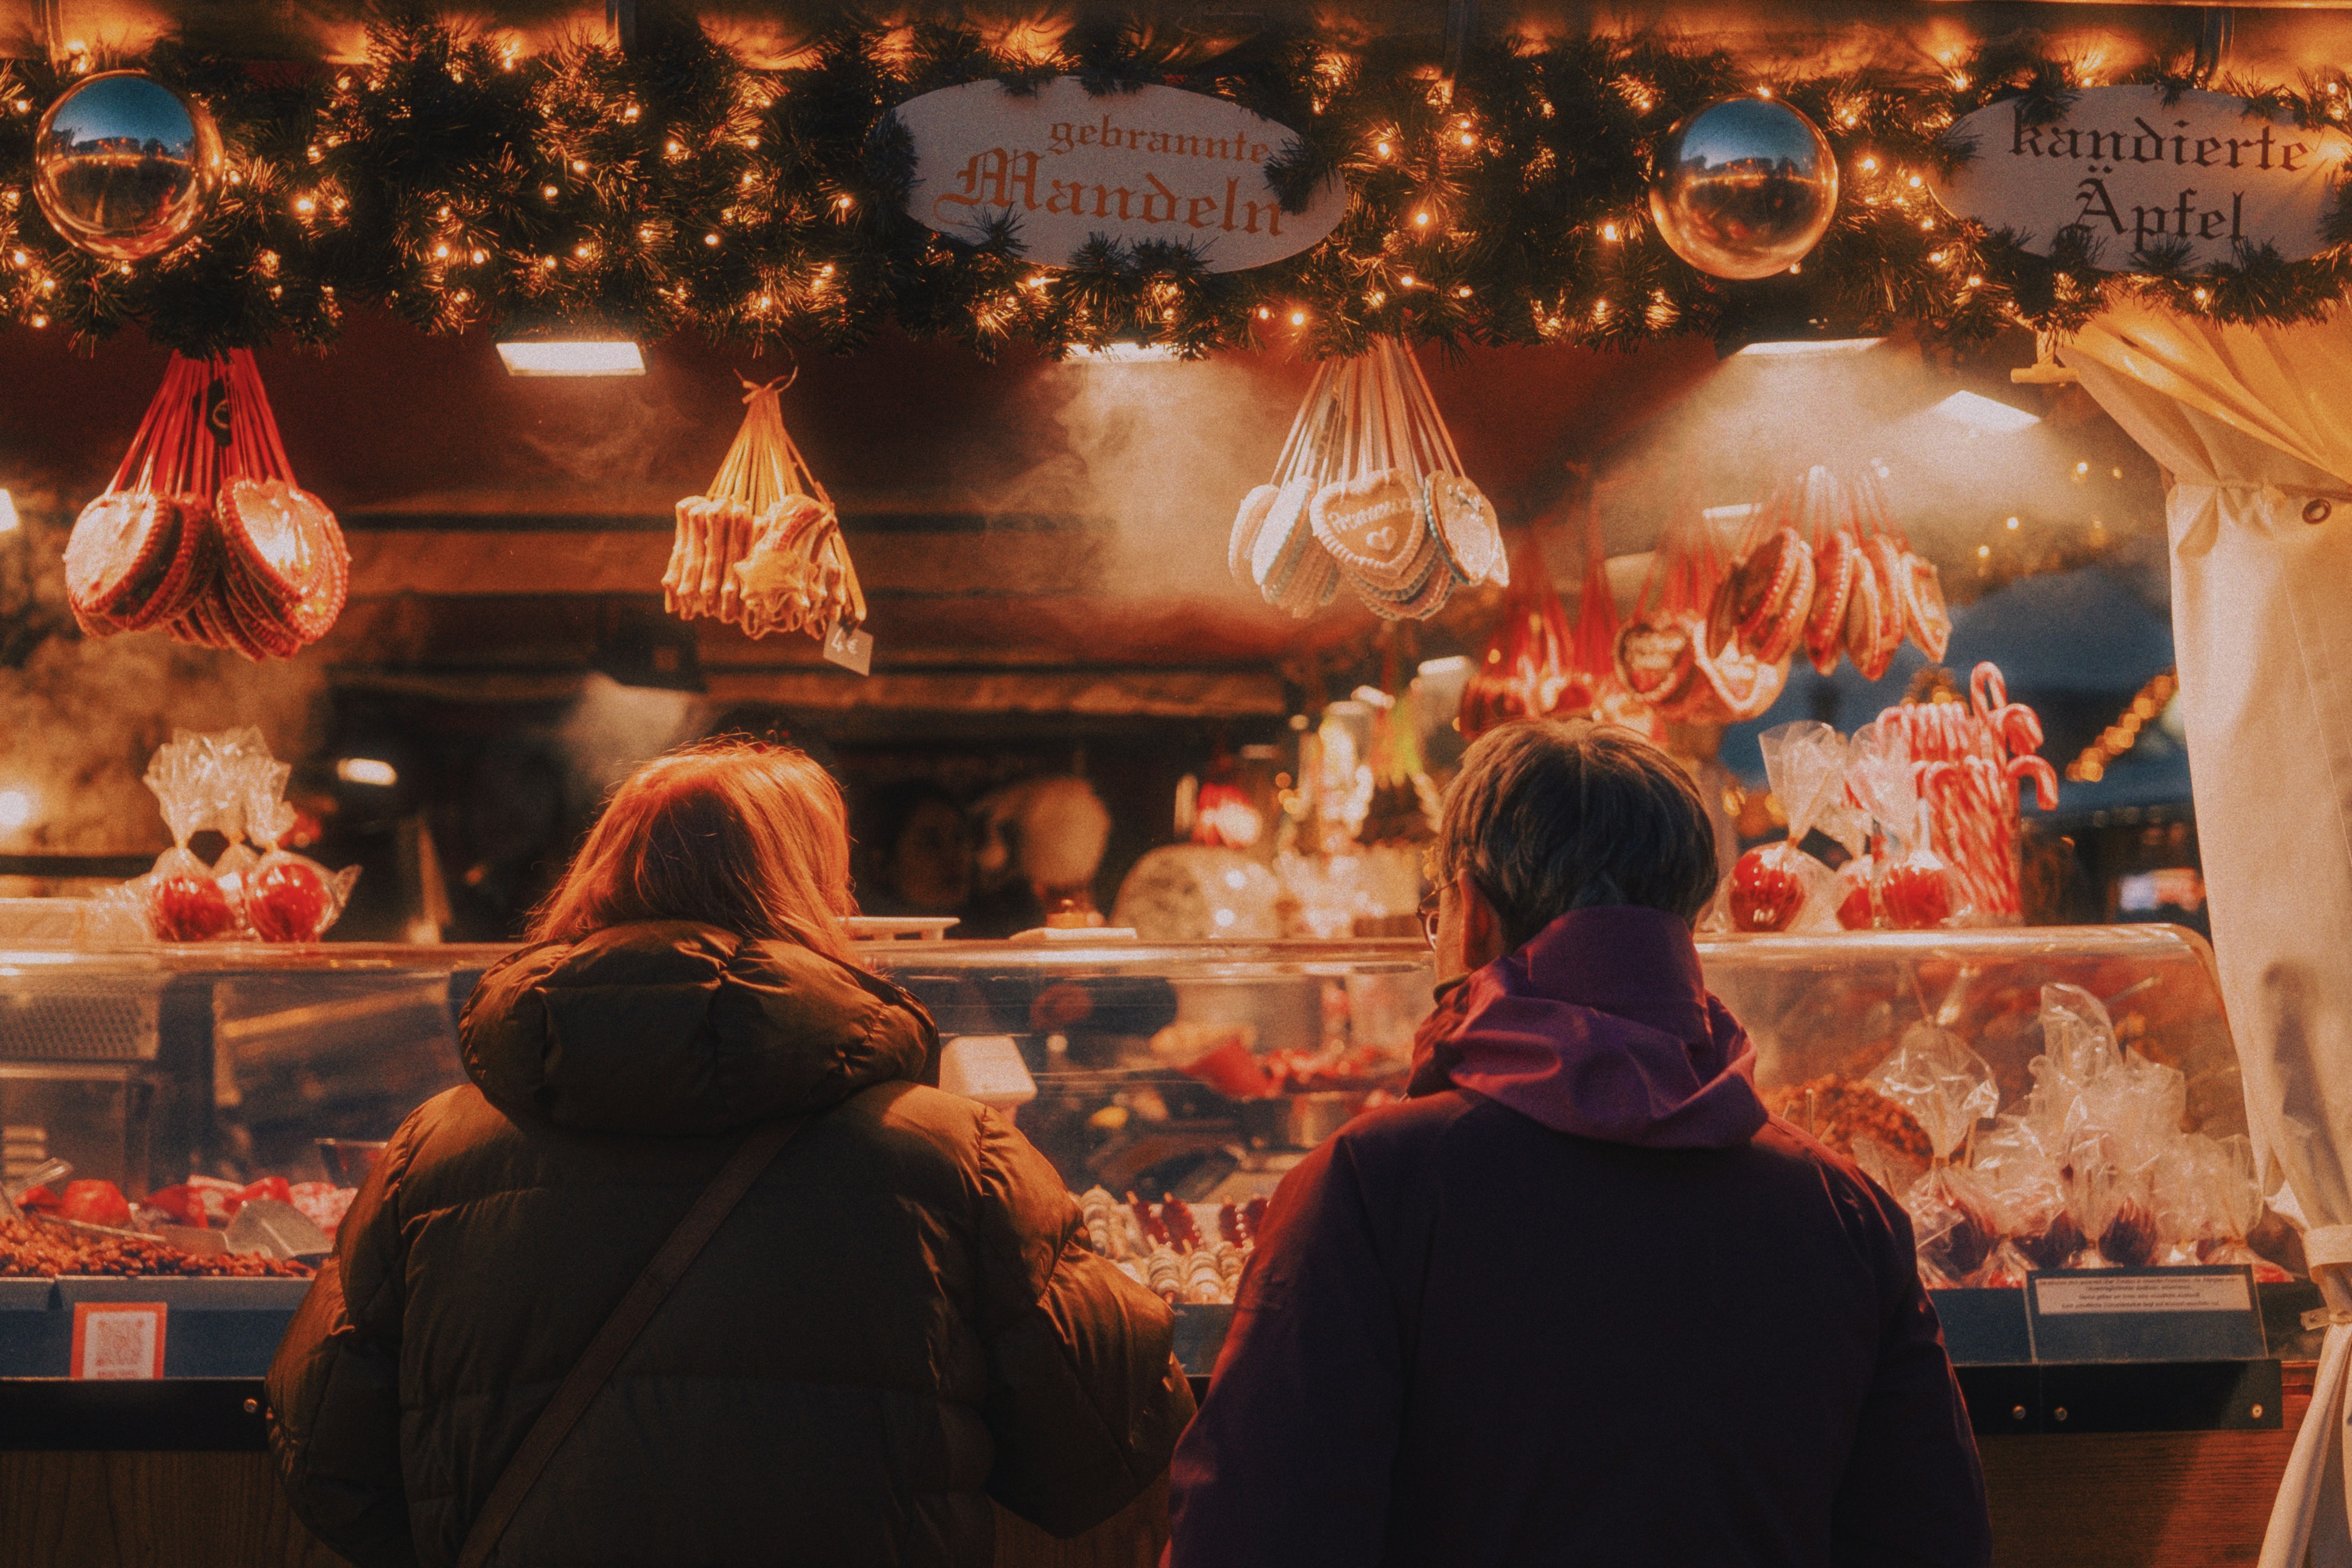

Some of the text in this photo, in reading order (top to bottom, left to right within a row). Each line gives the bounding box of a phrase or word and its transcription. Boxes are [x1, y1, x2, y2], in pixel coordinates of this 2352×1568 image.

[1045, 114, 1269, 164] gebrannte
[2008, 105, 2309, 172] kandierte
[933, 147, 1284, 237] Mandeln
[2061, 165, 2247, 253] Äpfel
